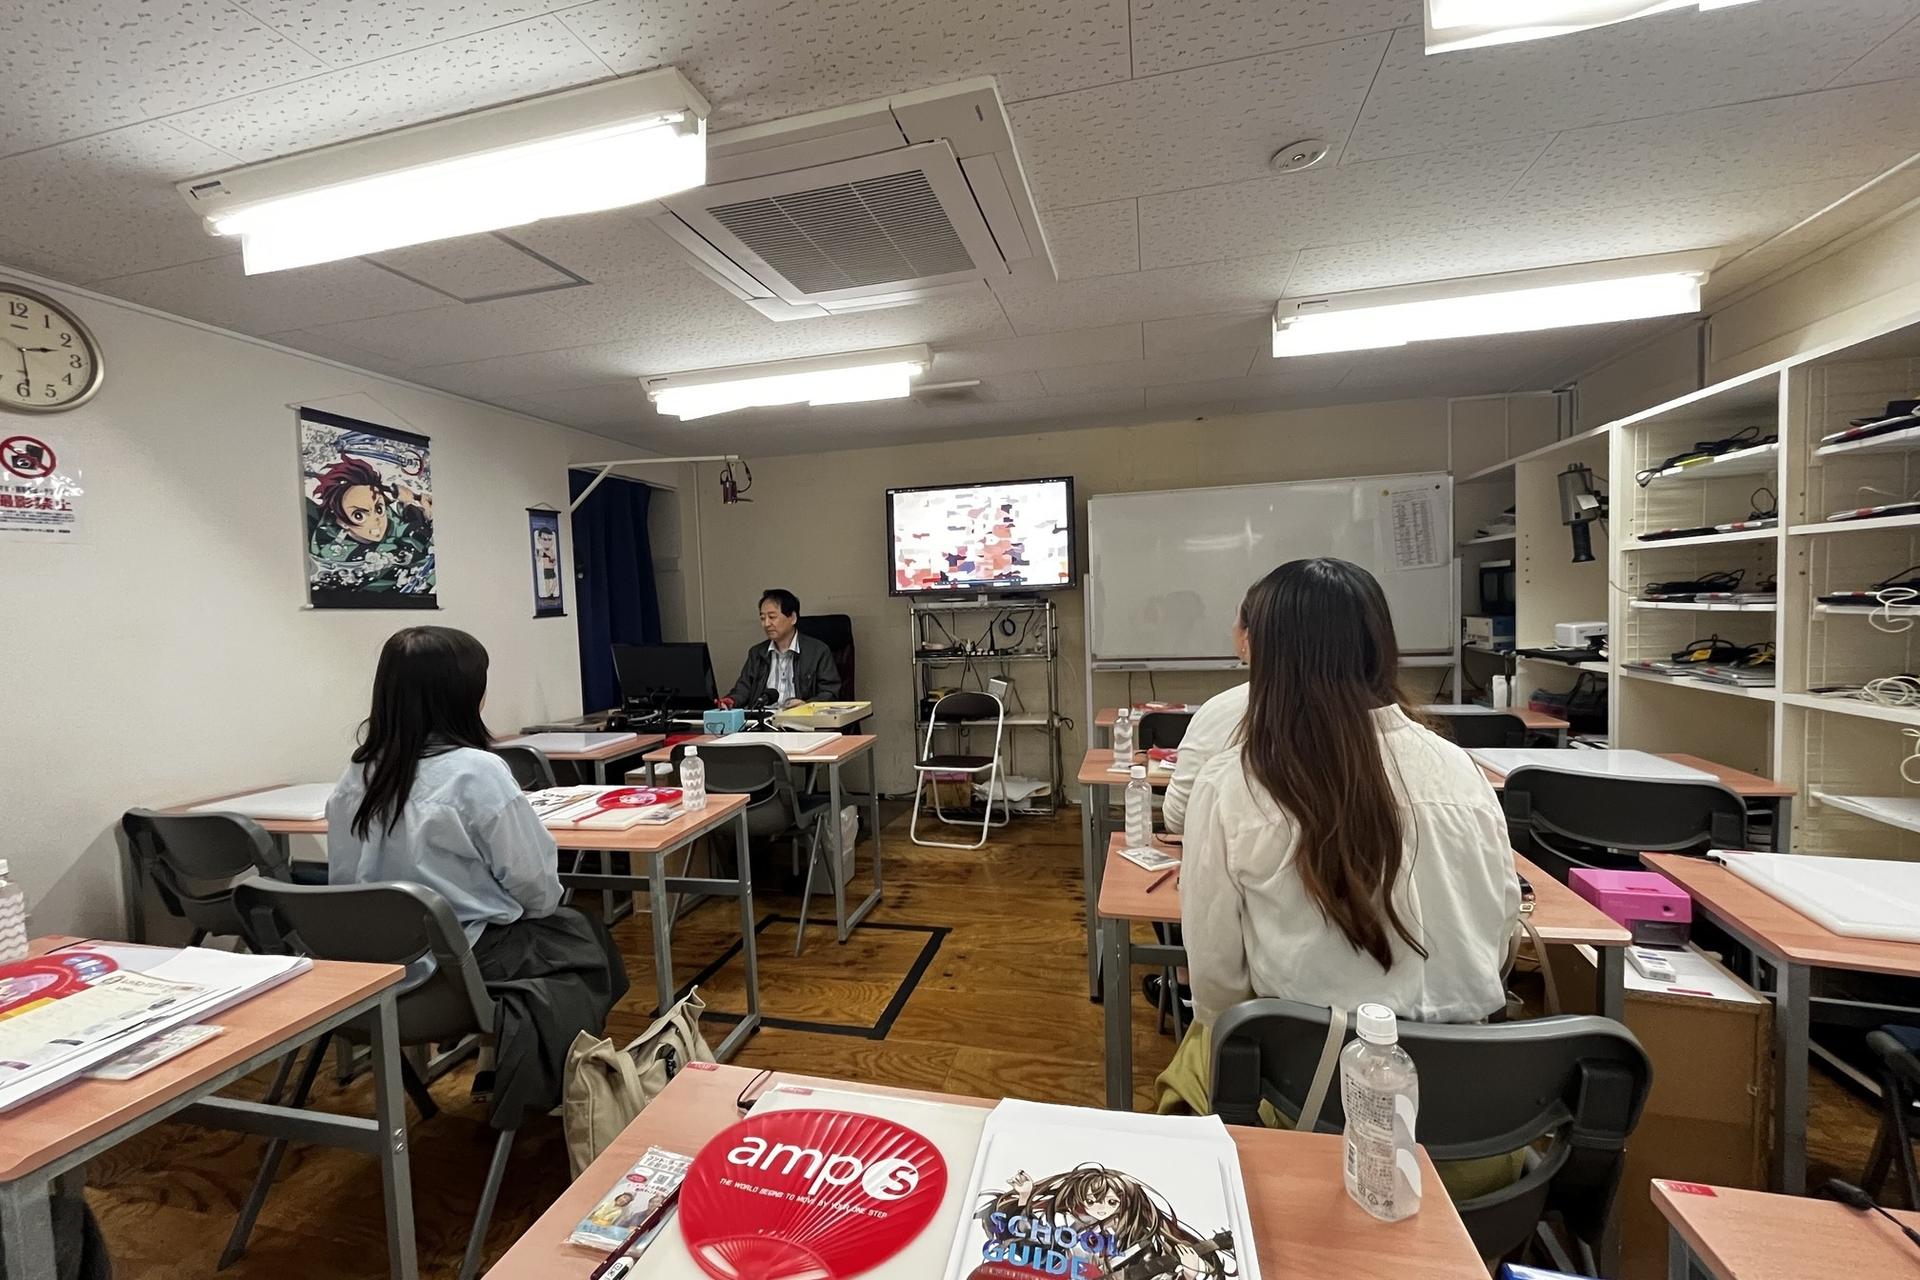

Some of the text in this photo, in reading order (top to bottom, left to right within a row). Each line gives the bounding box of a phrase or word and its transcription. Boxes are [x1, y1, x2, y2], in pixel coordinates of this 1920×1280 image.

[8, 301, 28, 319] 12
[44, 314, 50, 329] 1
[60, 333, 72, 348] 2
[69, 354, 82, 369] 3
[61, 373, 72, 386] 4
[16, 382, 30, 397] 6
[45, 384, 56, 398] 5
[720, 1178, 733, 1186] THE
[734, 1182, 759, 1193] WORLD
[759, 1188, 784, 1198] BEGINS
[796, 1195, 816, 1205] MOVE
[832, 1203, 850, 1213] YOUR
[852, 1206, 866, 1215] ONE
[868, 1209, 888, 1219] STEP
[990, 1211, 1126, 1257] SCHOOL
[983, 1239, 1090, 1280] GUIDE
